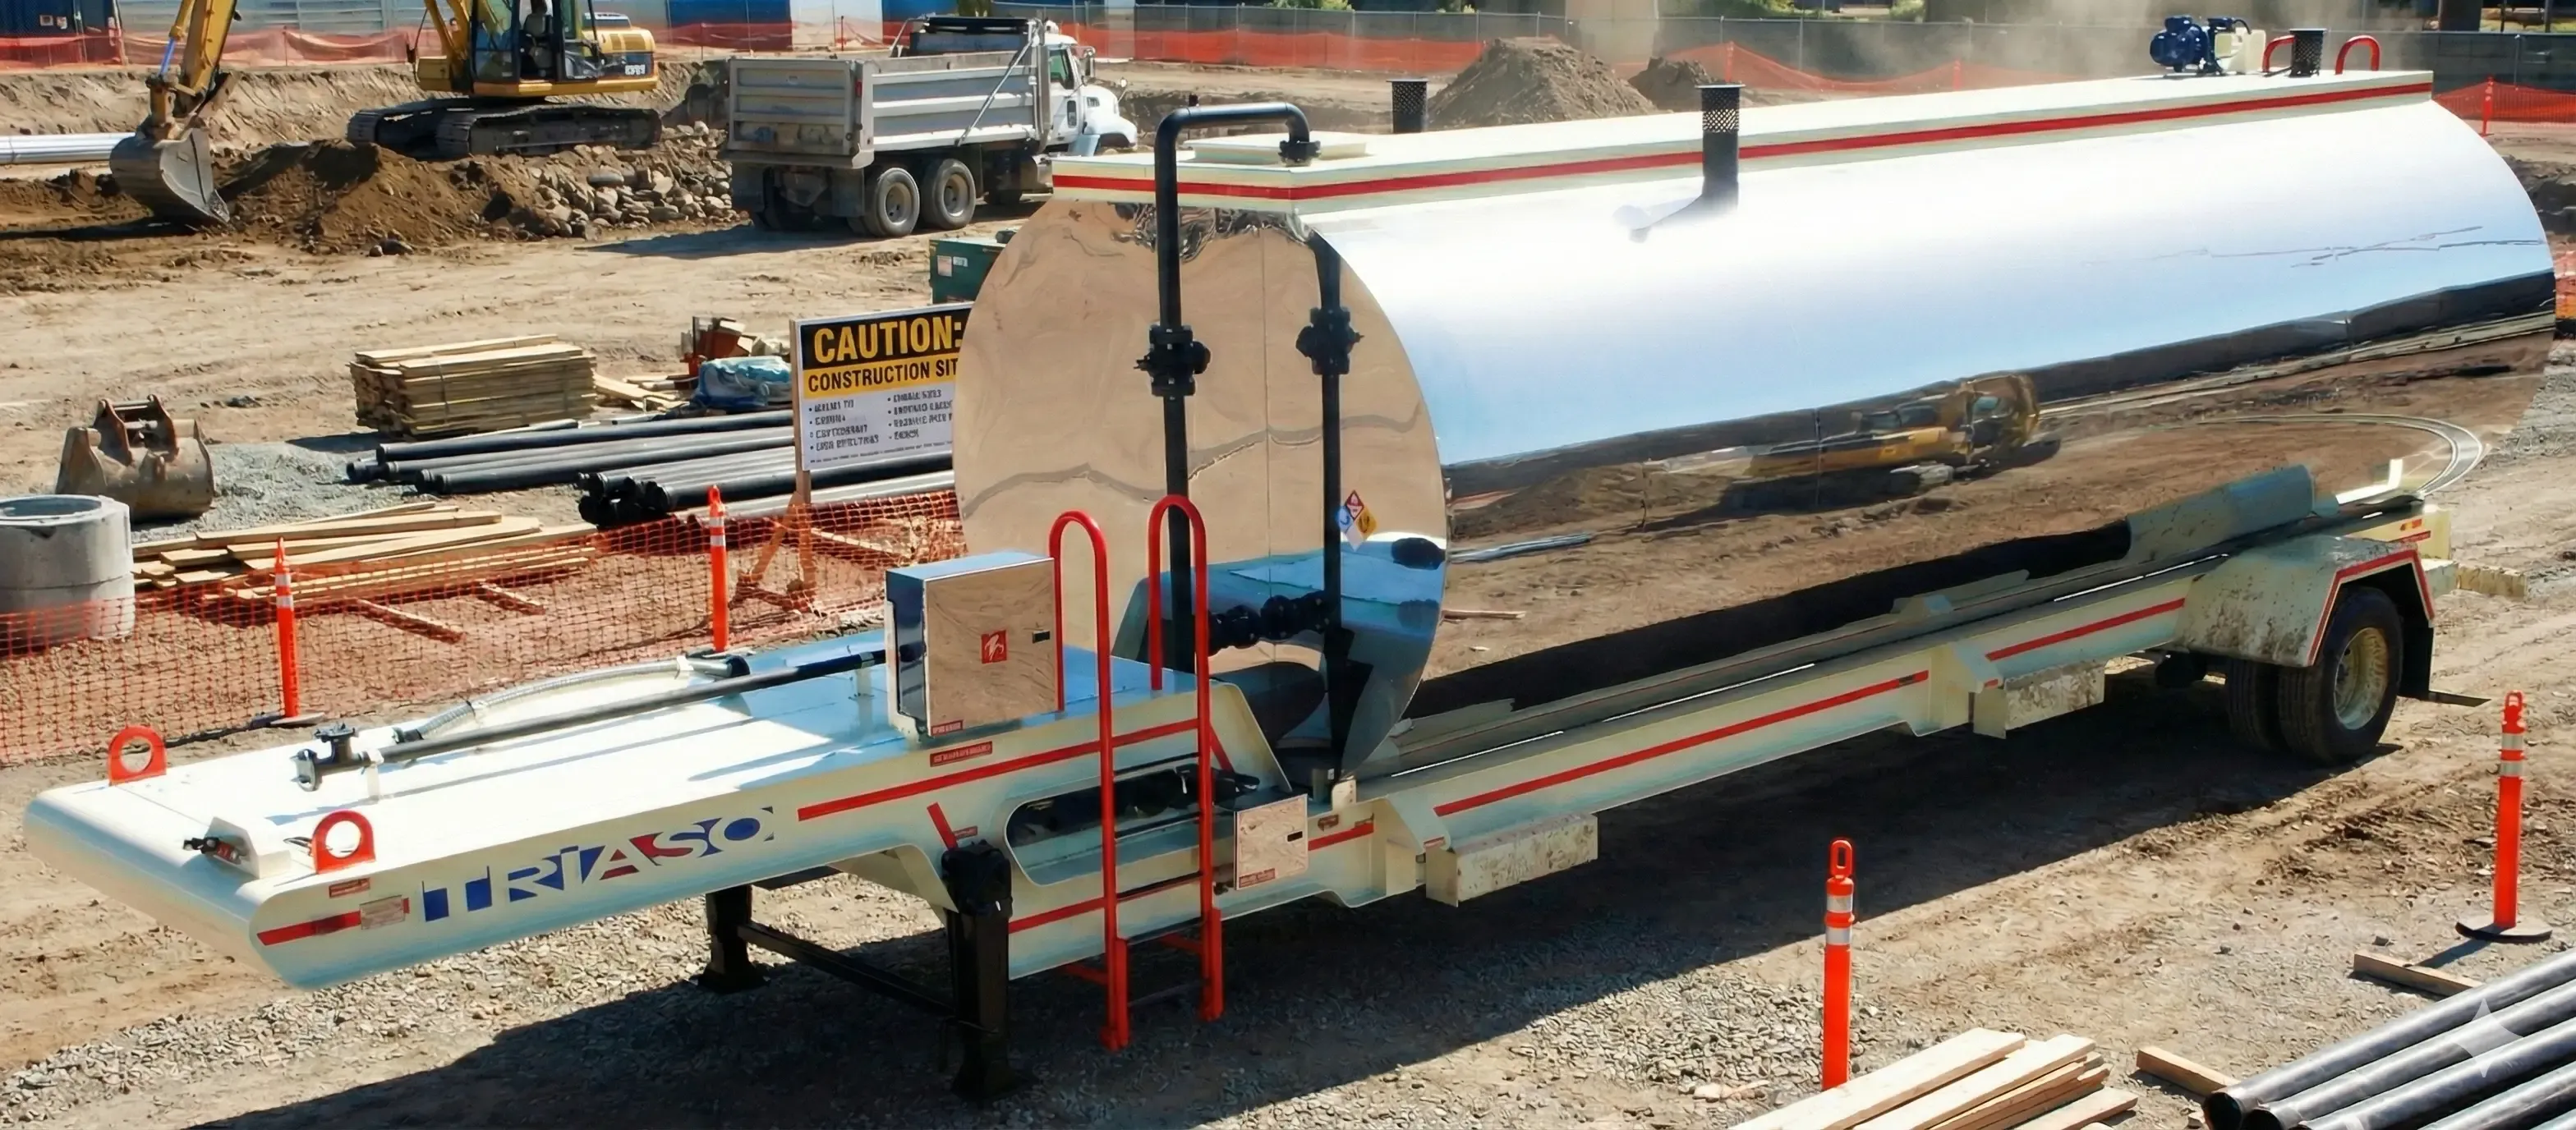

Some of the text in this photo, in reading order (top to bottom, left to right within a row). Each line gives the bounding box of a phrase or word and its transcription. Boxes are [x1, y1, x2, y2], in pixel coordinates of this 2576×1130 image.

[814, 315, 962, 364] CAUTION:
[808, 358, 959, 393] CONSTRUCTION SIT
[421, 804, 775, 922] TRIASO
